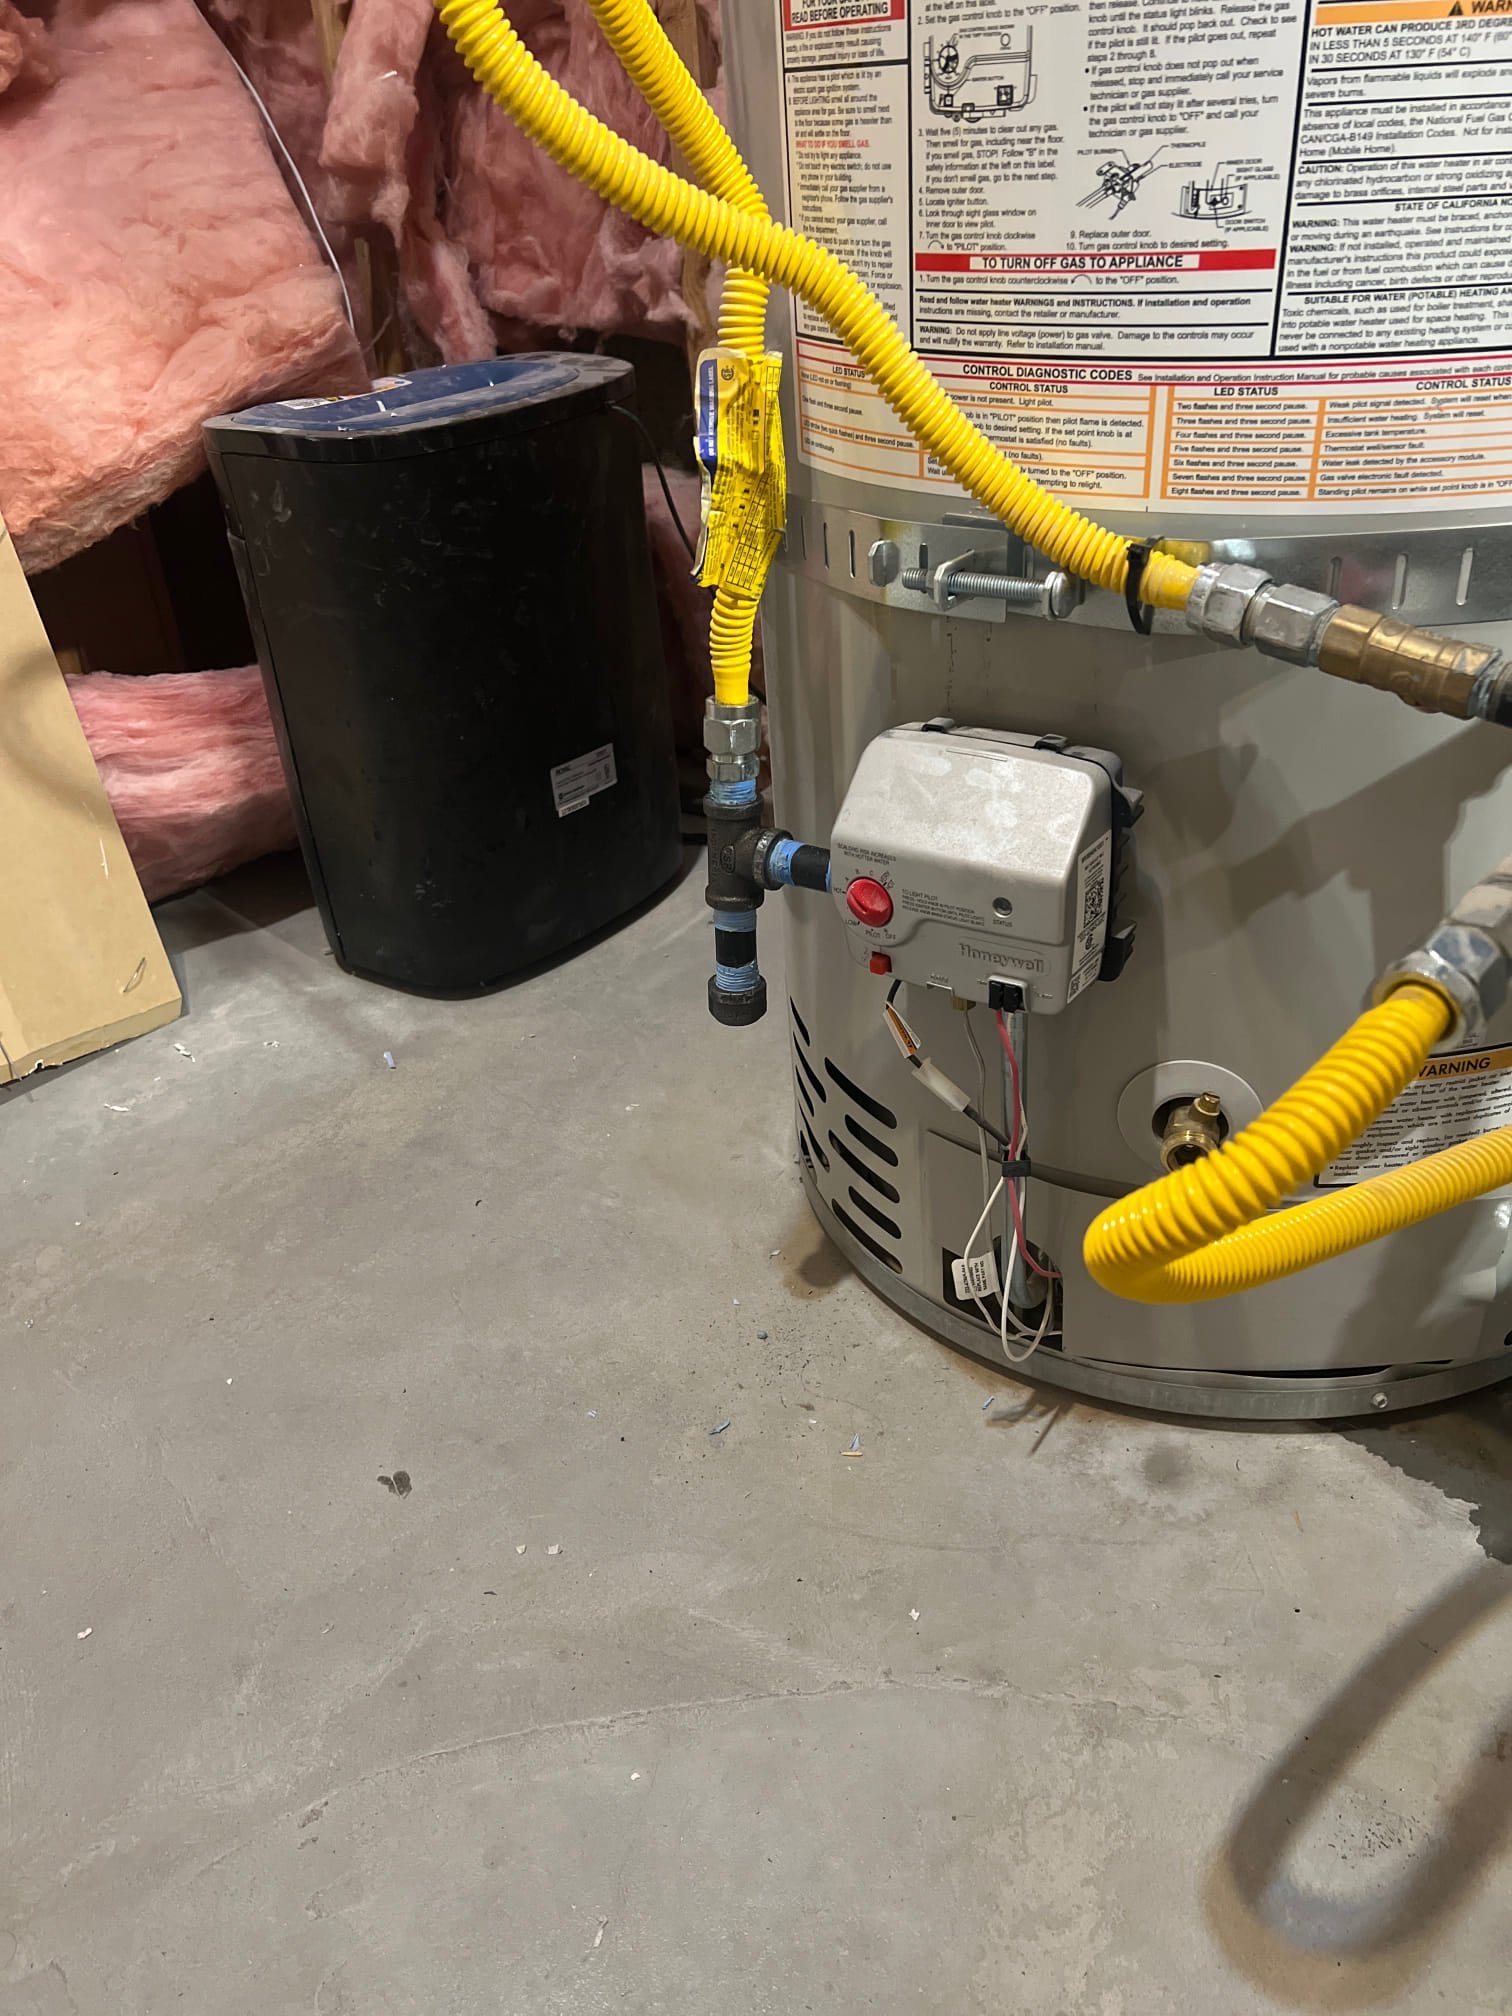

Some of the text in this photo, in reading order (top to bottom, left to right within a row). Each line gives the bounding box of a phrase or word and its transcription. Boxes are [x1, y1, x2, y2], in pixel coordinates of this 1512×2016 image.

[792, 4, 888, 24] READ BEFORE OPERATING
[1311, 27, 1332, 37] HOT
[1336, 25, 1372, 36] WATER
[1375, 24, 1397, 34] CAN
[1400, 20, 1452, 32] PRODUCE
[1455, 19, 1475, 30] 3RD
[1309, 41, 1320, 51] IN
[1322, 39, 1349, 51] LESS
[1353, 38, 1380, 48] THAN
[1392, 34, 1443, 47] SECONDS
[1445, 33, 1457, 44] AT
[1308, 54, 1319, 64] IN
[1321, 53, 1333, 64] 30
[1336, 50, 1387, 63] SECONDS
[1389, 49, 1400, 60] AT
[1459, 46, 1470, 58] C)
[931, 153, 942, 161] you
[943, 150, 959, 159] smell
[1001, 148, 1024, 157] Follow
[1395, 198, 1497, 212] STATE OF CALIFORNIA
[1343, 218, 1359, 226] This
[1387, 216, 1413, 224] heater
[1416, 214, 1436, 222] must
[1438, 214, 1448, 222] be
[1079, 241, 1095, 250] Turn
[1097, 243, 1110, 252] gas
[1112, 241, 1137, 250] control
[1139, 241, 1158, 249] knob
[1160, 241, 1167, 249] to
[1170, 239, 1199, 249] desired
[983, 255, 1182, 270] TO TURN OFF GAS TO APPLIANCE
[926, 274, 940, 283] Turn
[941, 275, 951, 283] the
[952, 276, 964, 285] gas
[966, 276, 988, 284] control
[989, 276, 1006, 284] knob
[1008, 276, 1068, 285] counterclockwise
[1095, 276, 1103, 285] to
[1105, 276, 1117, 285] the
[919, 295, 934, 303] Read
[936, 296, 947, 304] and
[949, 296, 968, 304] follow
[990, 298, 1011, 306] heater
[1013, 298, 1054, 307] WARNINGS
[1056, 299, 1070, 307] and
[1145, 298, 1190, 307] installation
[1192, 298, 1208, 306] and
[1210, 297, 1250, 307] operation
[1304, 295, 1349, 304] SUITABLE
[1351, 294, 1371, 302] FOR
[1373, 292, 1405, 301] WATER
[1459, 287, 1498, 297] HEATING
[1278, 343, 1299, 352] used
[1301, 343, 1318, 351] with
[1329, 341, 1376, 351] nonpotable
[1378, 340, 1402, 348] water
[1404, 339, 1435, 348] heating
[833, 366, 867, 378] LED STATUS
[962, 364, 1132, 380] CONTROL DIAGNOSTIC CODES
[989, 381, 1067, 393] CONTROL STATUS
[1416, 376, 1511, 390] CONTROL STATUS
[1214, 386, 1278, 396] LED STATUS
[1019, 397, 1035, 407] Light
[1178, 402, 1191, 410] Two
[1193, 402, 1218, 410] flashes
[1017, 415, 1043, 423] position
[1045, 416, 1060, 424] then
[1062, 417, 1077, 426] pilot
[1079, 417, 1099, 426] flame
[1171, 487, 1188, 496] Eight
[1190, 487, 1214, 495] flashes
[993, 919, 1013, 927] STATUS
[865, 930, 881, 938] PILOT
[885, 932, 896, 940] OFF
[958, 943, 1044, 973] Honeywell
